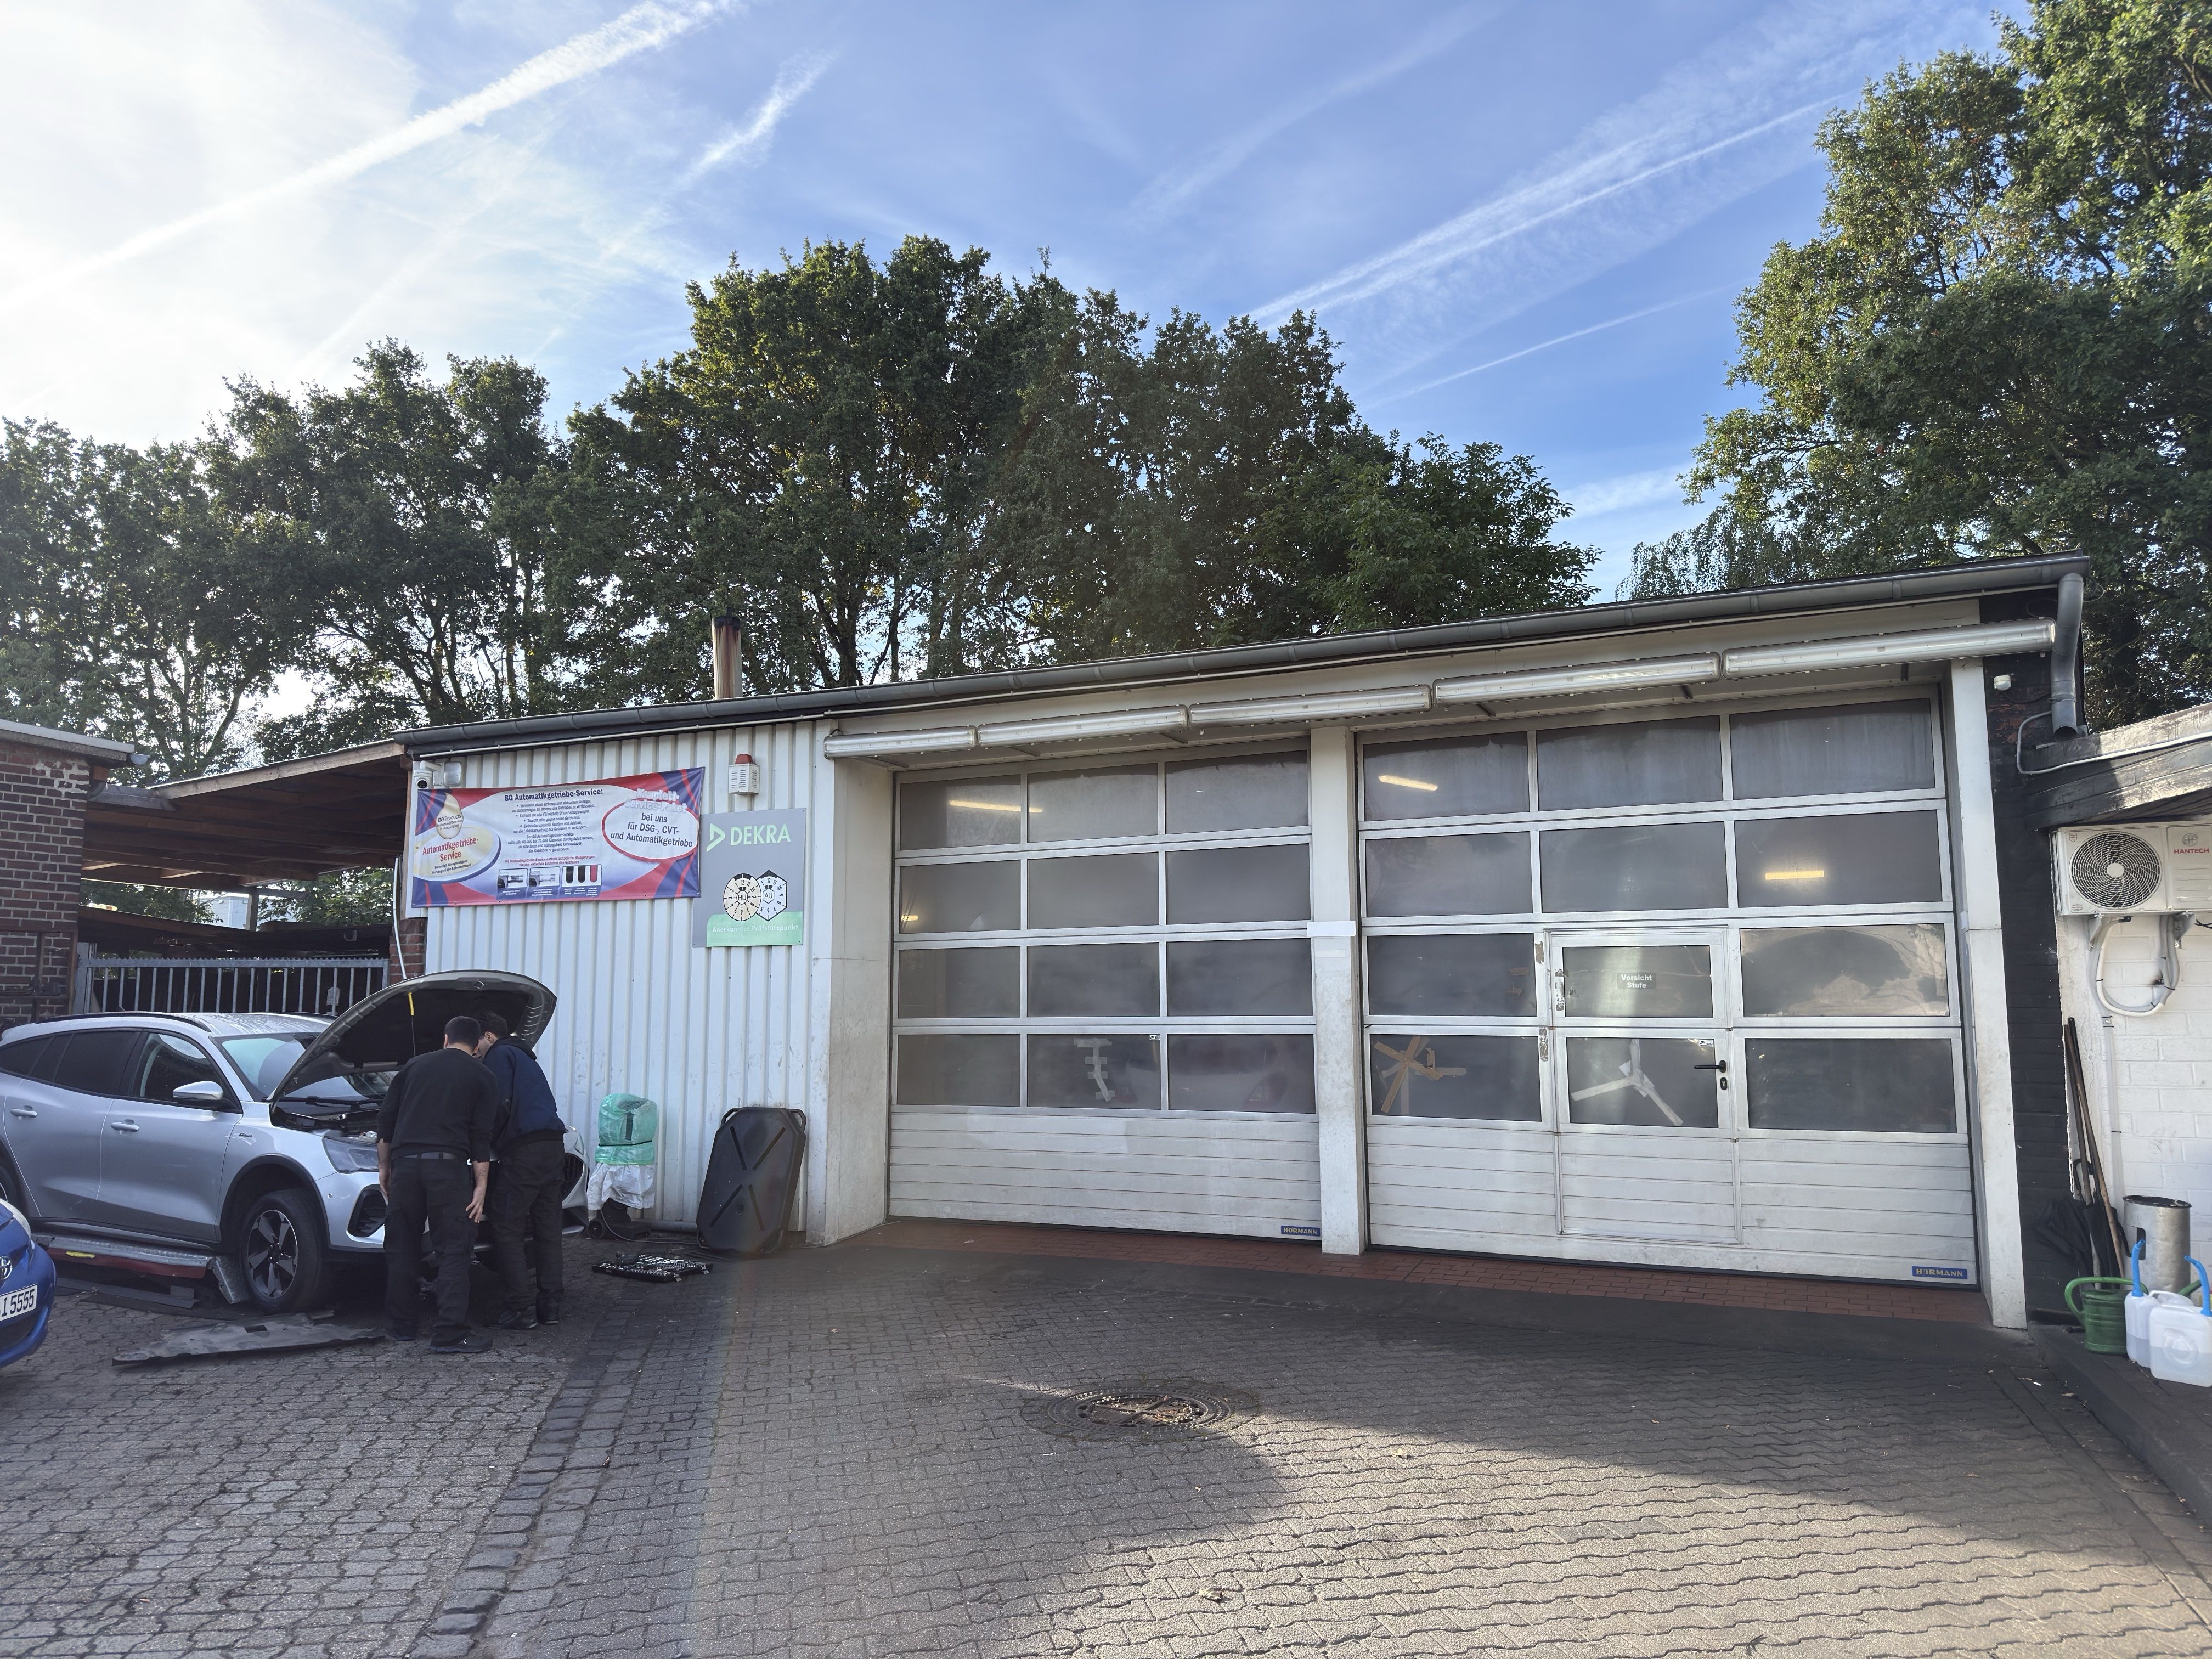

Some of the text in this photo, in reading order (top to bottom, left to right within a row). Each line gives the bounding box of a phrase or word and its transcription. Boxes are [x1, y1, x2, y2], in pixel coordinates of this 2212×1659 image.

[515, 788, 603, 801] Automatikgetriebe-Service:
[636, 788, 679, 801] Komplett-
[624, 799, 687, 813] Service-Paket
[628, 822, 679, 834] für DSG-, CVT-
[731, 823, 791, 846] DEKRA
[422, 837, 478, 855] Automatikgetriebe-
[626, 833, 692, 847] Automatikgetriebe
[440, 851, 461, 862] Service
[752, 924, 798, 932] Prüfstützpunkt
[10, 1289, 35, 1314] 5555
